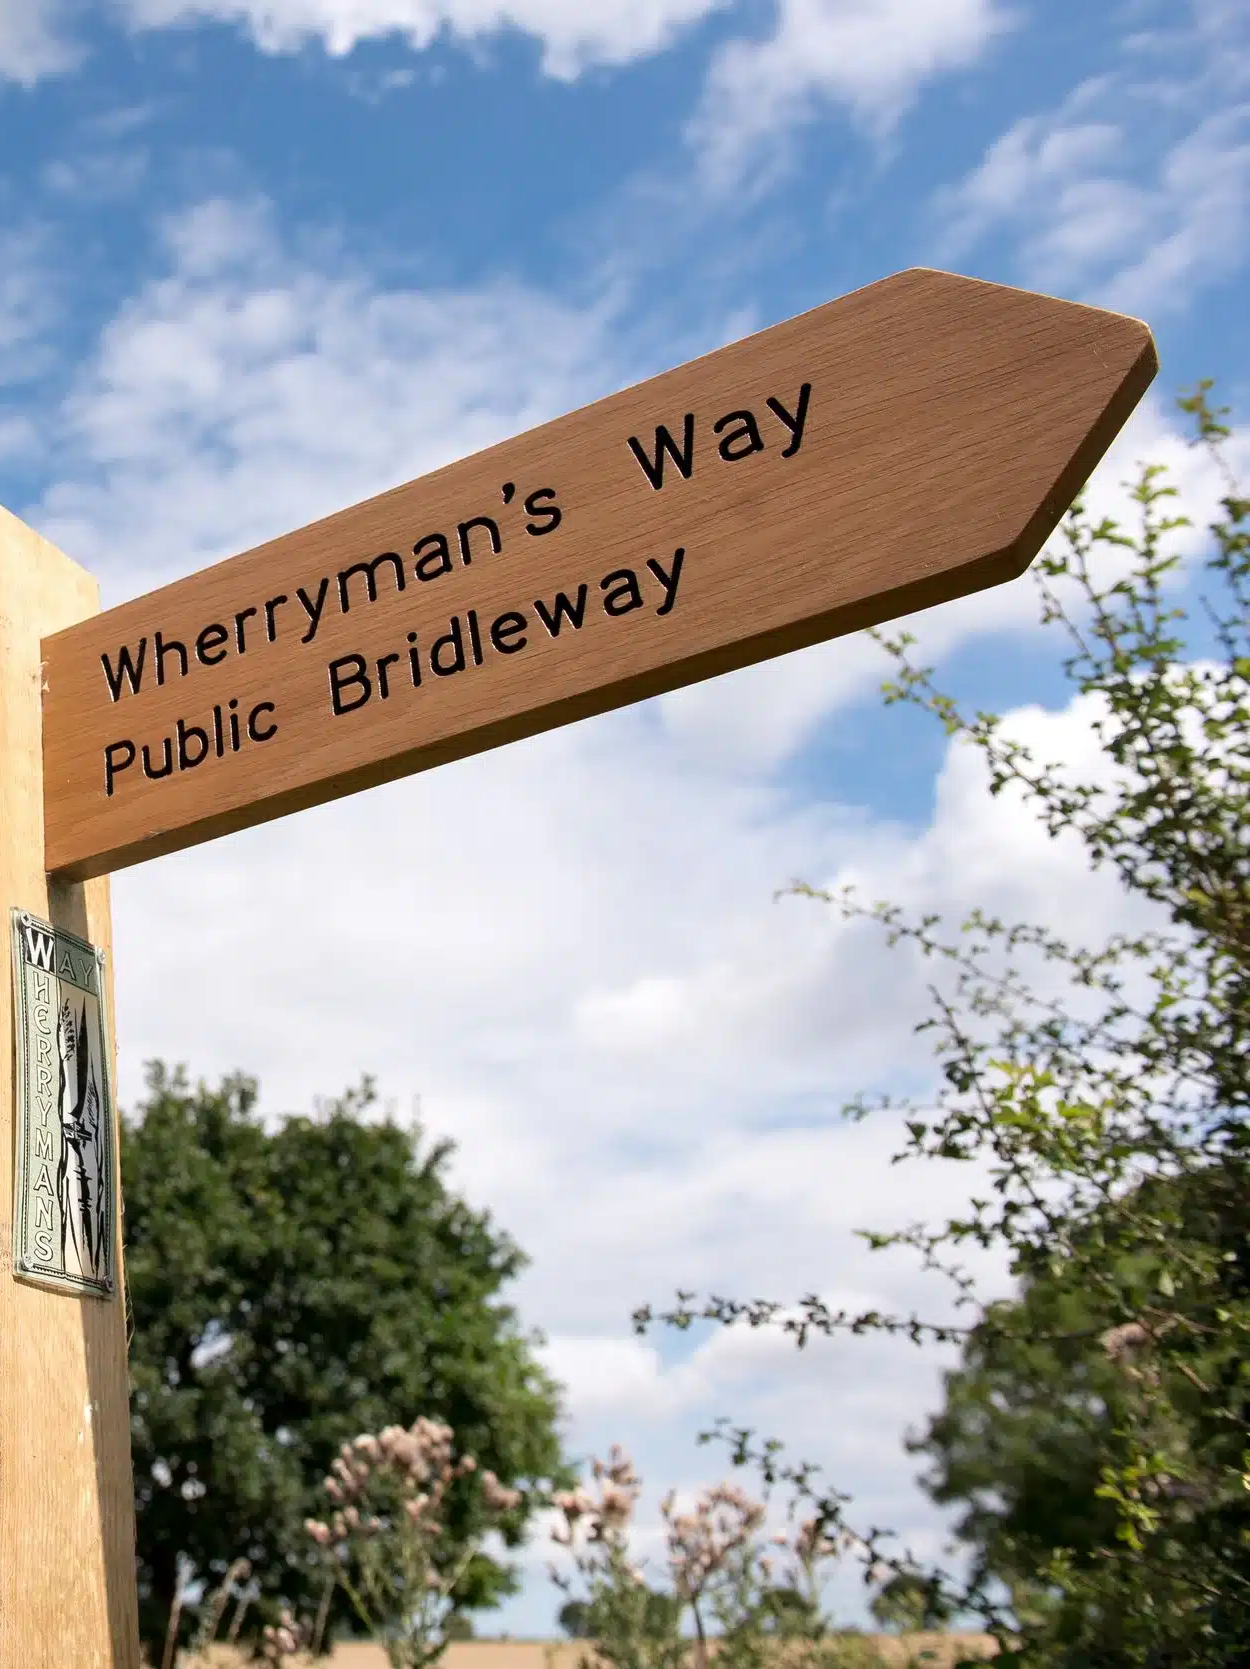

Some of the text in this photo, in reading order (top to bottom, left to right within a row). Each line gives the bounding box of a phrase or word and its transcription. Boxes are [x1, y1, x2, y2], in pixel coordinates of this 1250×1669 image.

[100, 383, 812, 703] Wherryman's Way
[104, 547, 686, 797] Public Bridleway
